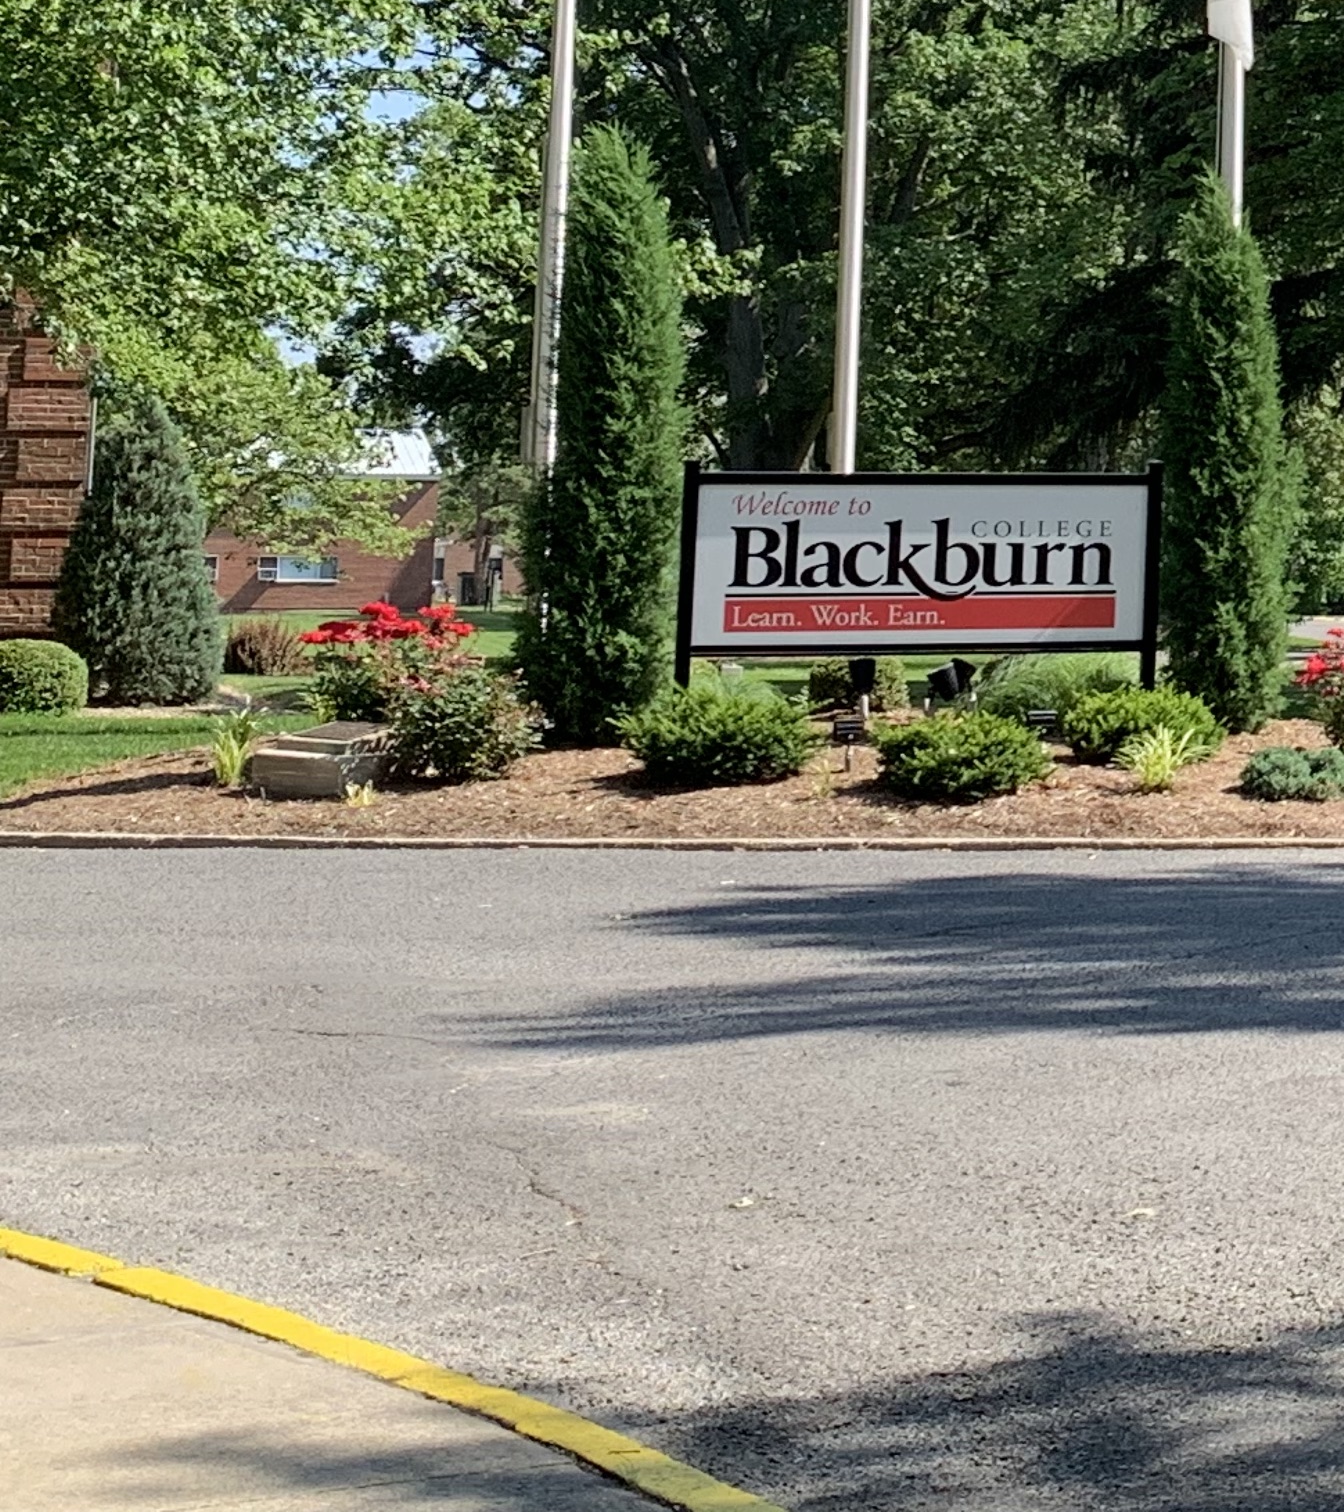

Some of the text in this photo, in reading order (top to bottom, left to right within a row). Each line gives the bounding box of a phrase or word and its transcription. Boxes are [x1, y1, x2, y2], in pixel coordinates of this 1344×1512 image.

[732, 491, 872, 516] Welcome to
[971, 520, 1113, 538] COLLEGE
[727, 517, 1115, 602] Blackburn
[732, 603, 946, 627] Learn. Work. Earn.
